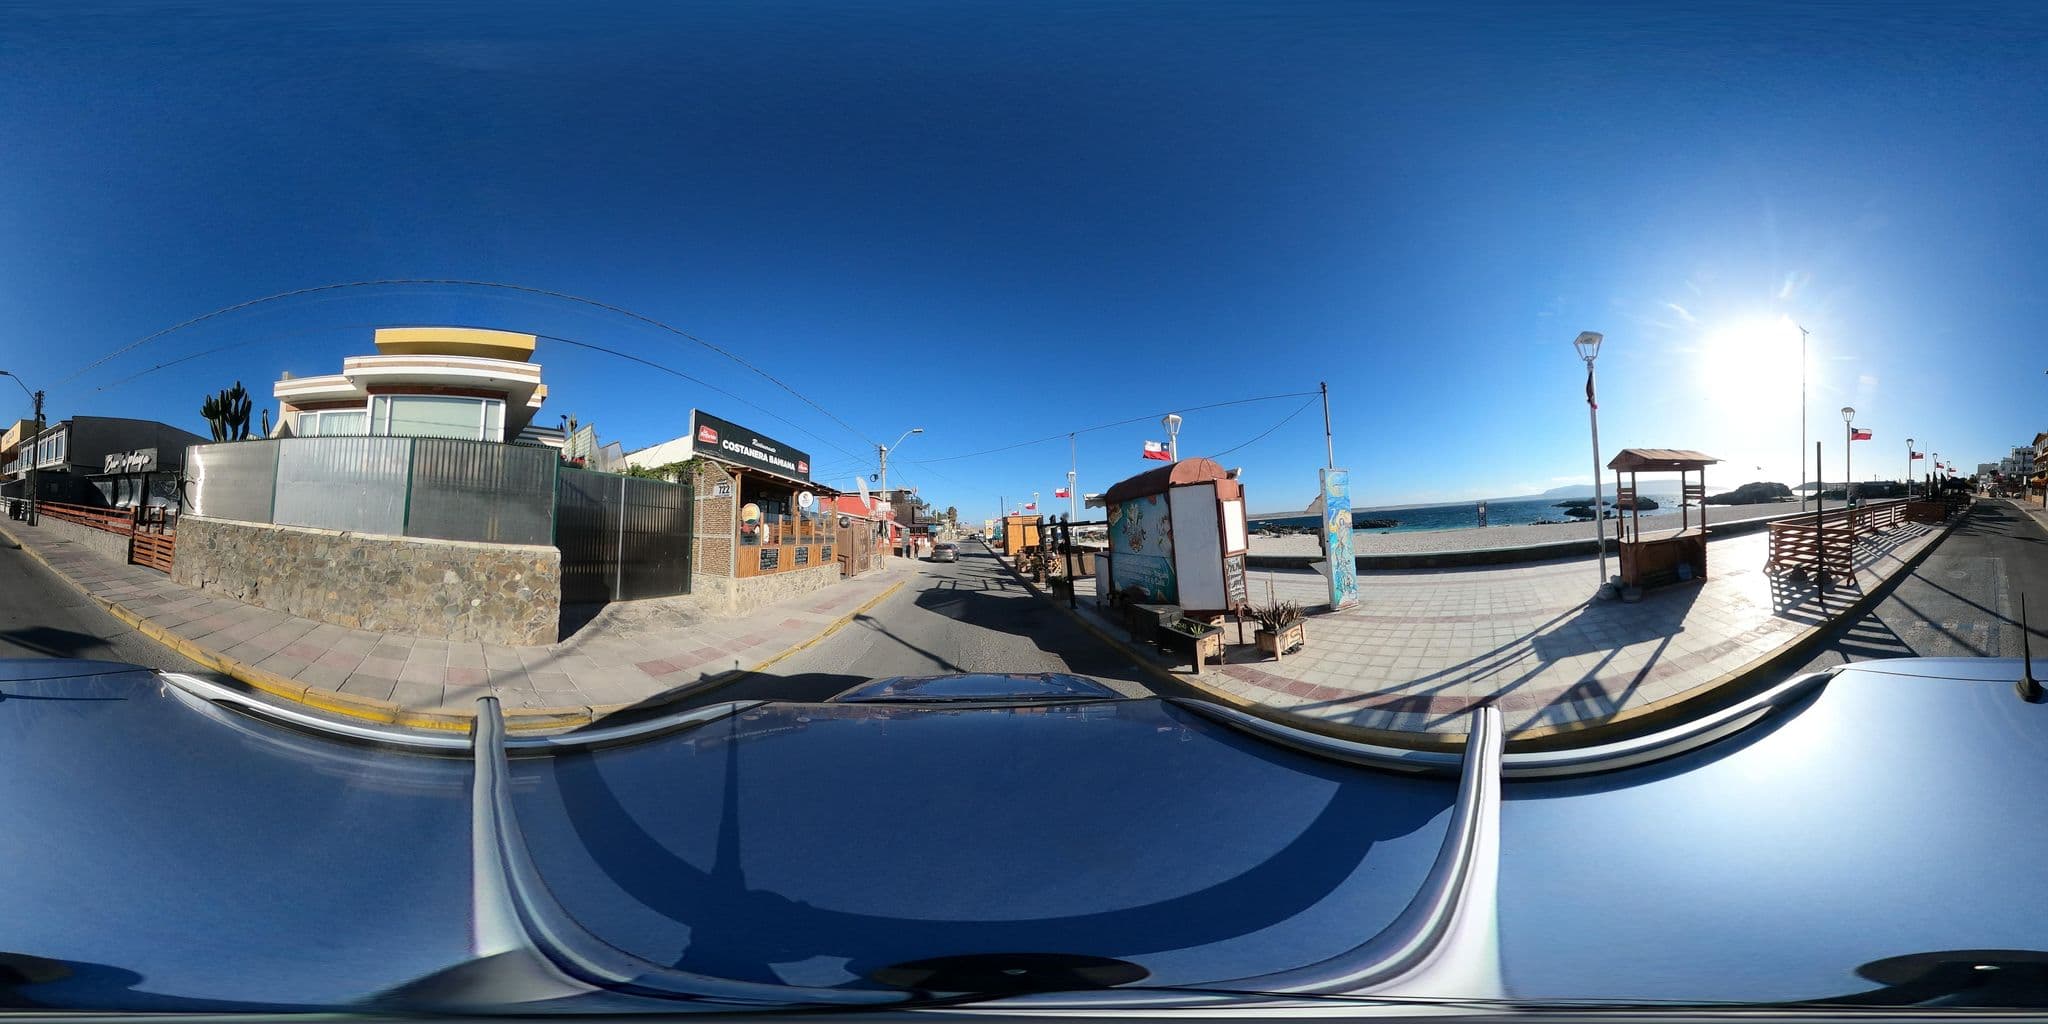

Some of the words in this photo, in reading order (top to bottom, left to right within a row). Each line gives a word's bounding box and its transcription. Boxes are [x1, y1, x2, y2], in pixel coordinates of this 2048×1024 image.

[126, 451, 150, 473] playa
[722, 440, 768, 462] COSTANERA
[769, 456, 795, 471] BAHIANA
[719, 485, 730, 495] 722
